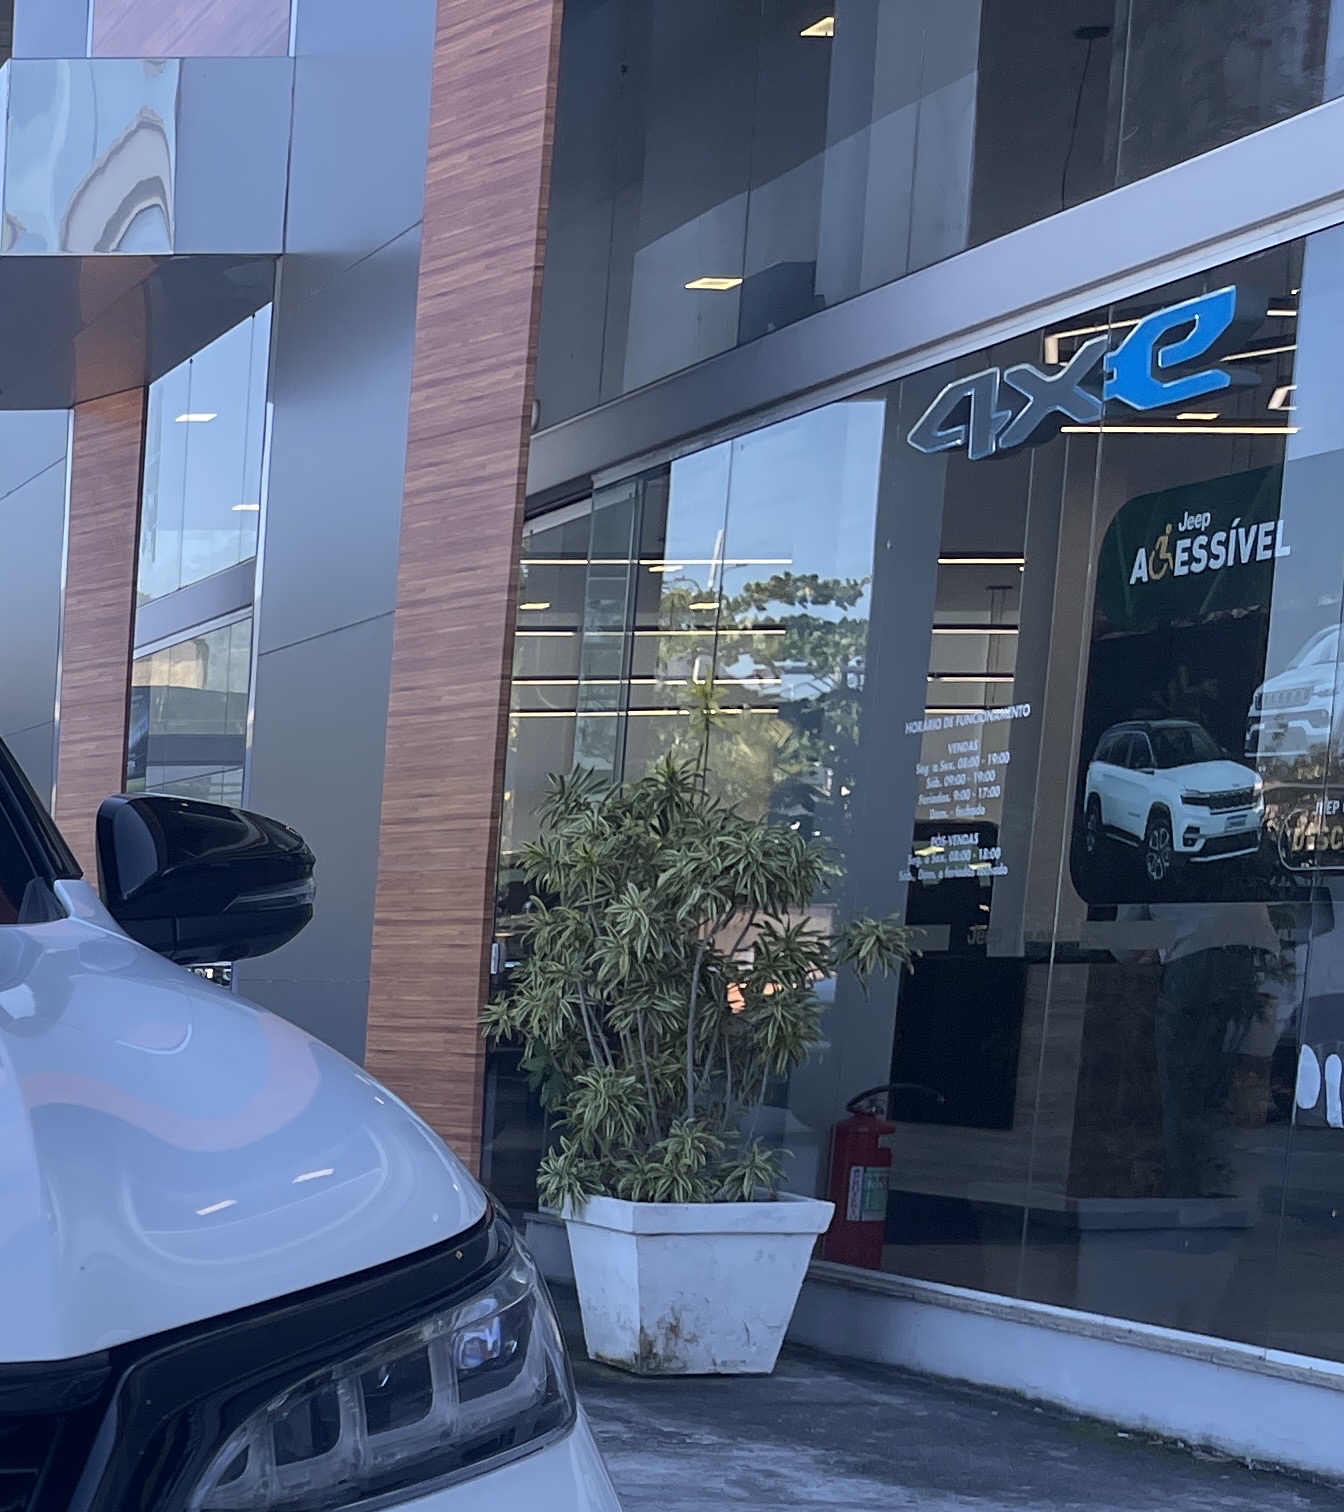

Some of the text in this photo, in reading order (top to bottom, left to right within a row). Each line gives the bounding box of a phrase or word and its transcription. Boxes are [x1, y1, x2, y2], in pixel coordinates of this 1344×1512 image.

[1178, 511, 1211, 532] Jeep
[943, 716, 954, 728] DE
[947, 739, 979, 754] VENDAS
[978, 785, 1001, 799] 17:00
